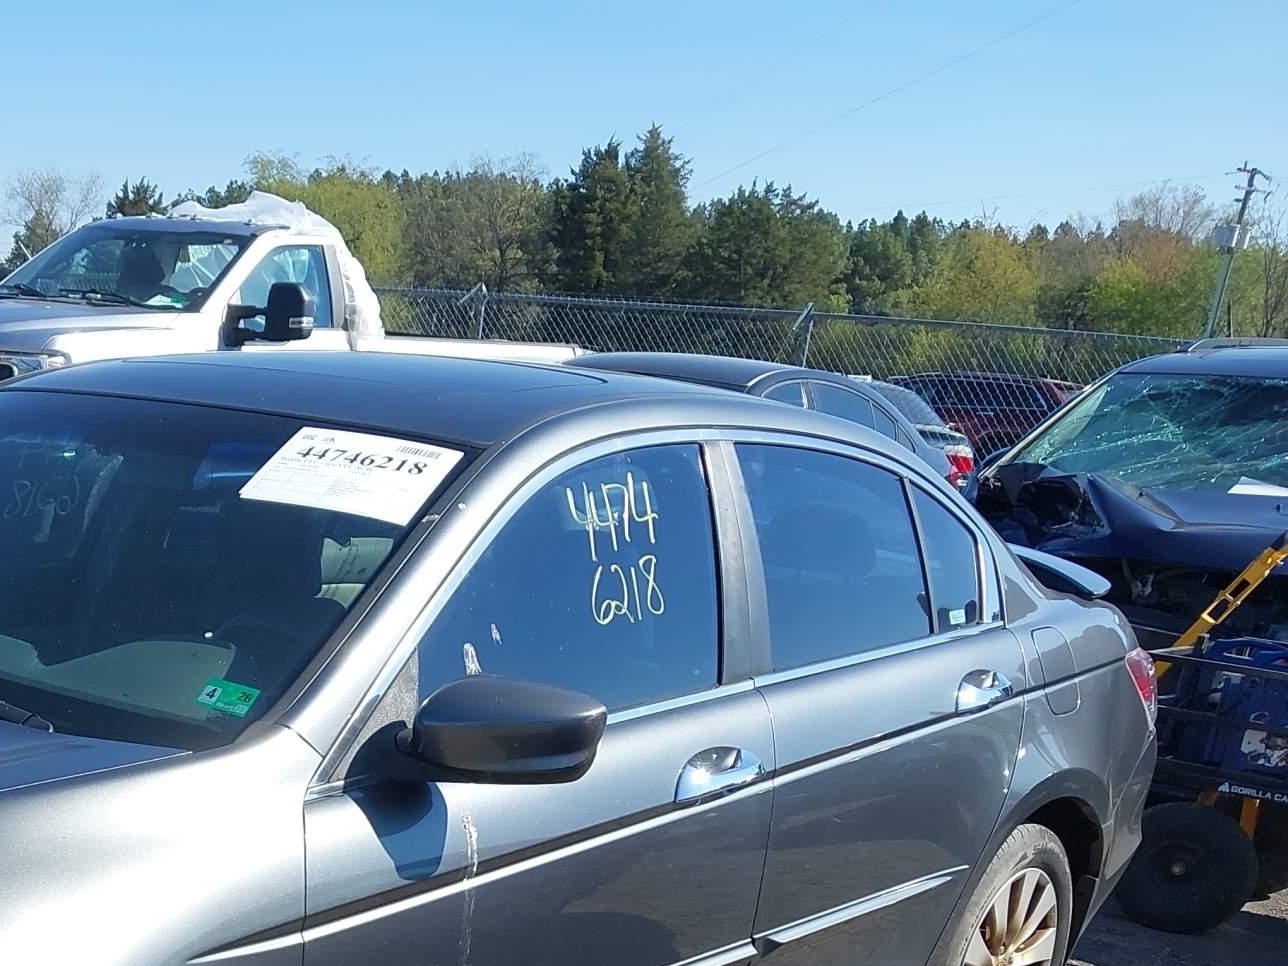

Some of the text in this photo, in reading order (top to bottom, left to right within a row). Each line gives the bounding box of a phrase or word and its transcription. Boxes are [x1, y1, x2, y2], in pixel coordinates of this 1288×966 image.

[295, 446, 428, 476] 44746218
[592, 555, 664, 625] 6218
[206, 688, 253, 703] 4 26
[1231, 785, 1272, 800] GORILLA
